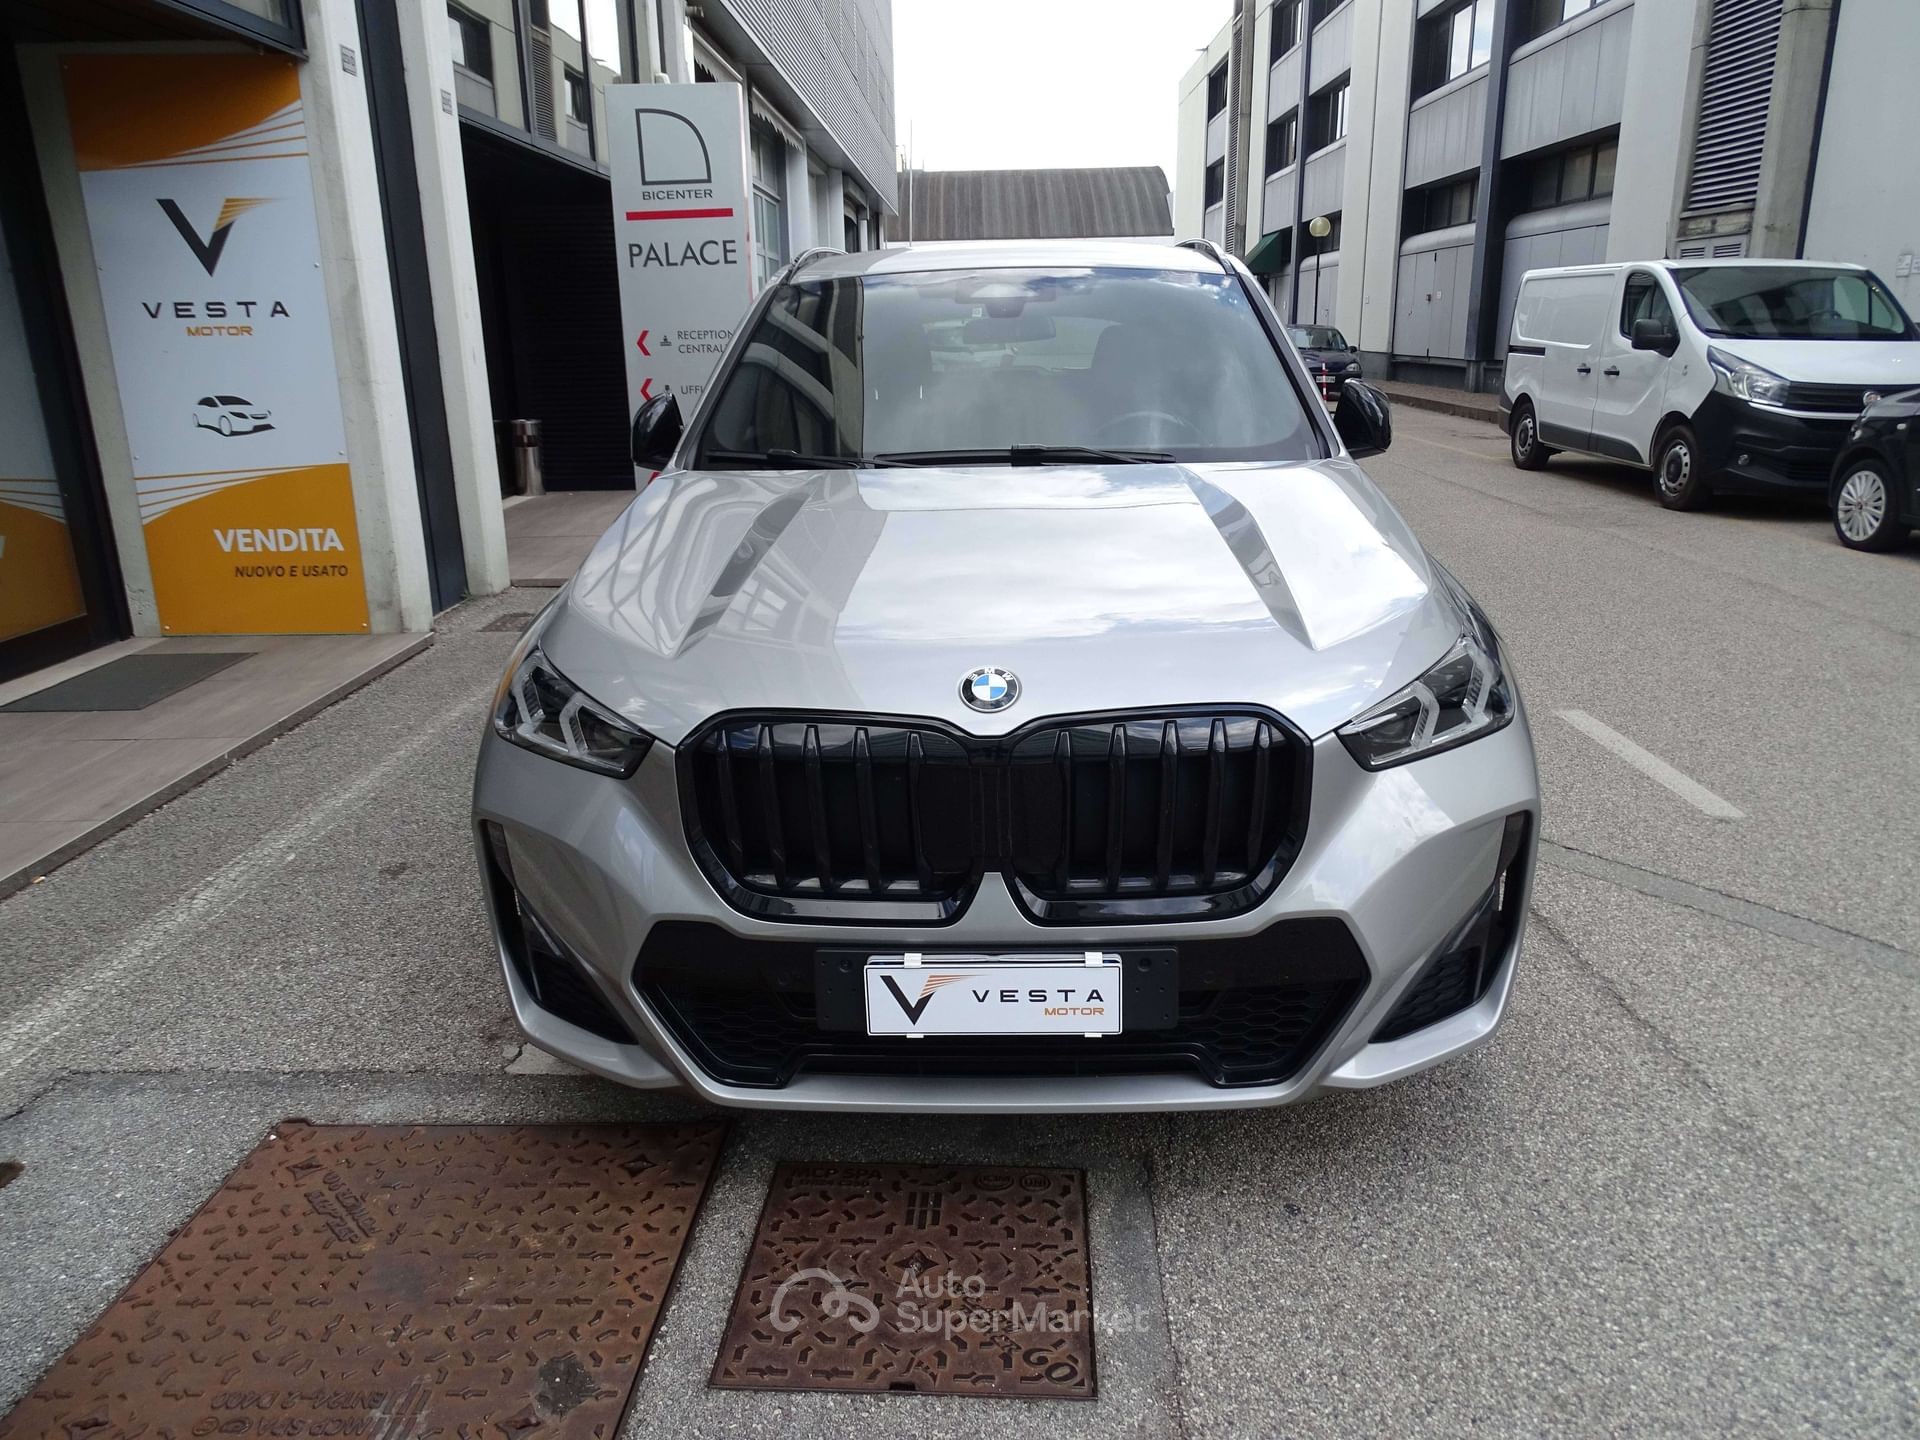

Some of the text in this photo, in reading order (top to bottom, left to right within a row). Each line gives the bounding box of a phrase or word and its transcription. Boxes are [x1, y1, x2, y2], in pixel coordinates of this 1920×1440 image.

[642, 189, 713, 200] BICENTER
[628, 240, 737, 268] PALACE
[142, 301, 290, 318] VESTA
[186, 326, 253, 336] MOTOR
[678, 343, 728, 354] CENTRAL
[213, 528, 345, 552] VENDITA
[235, 565, 348, 577] NUOVO E USATO
[967, 667, 1014, 681] BMW
[972, 989, 1105, 1003] VESTA
[1044, 1007, 1105, 1016] MOTOR
